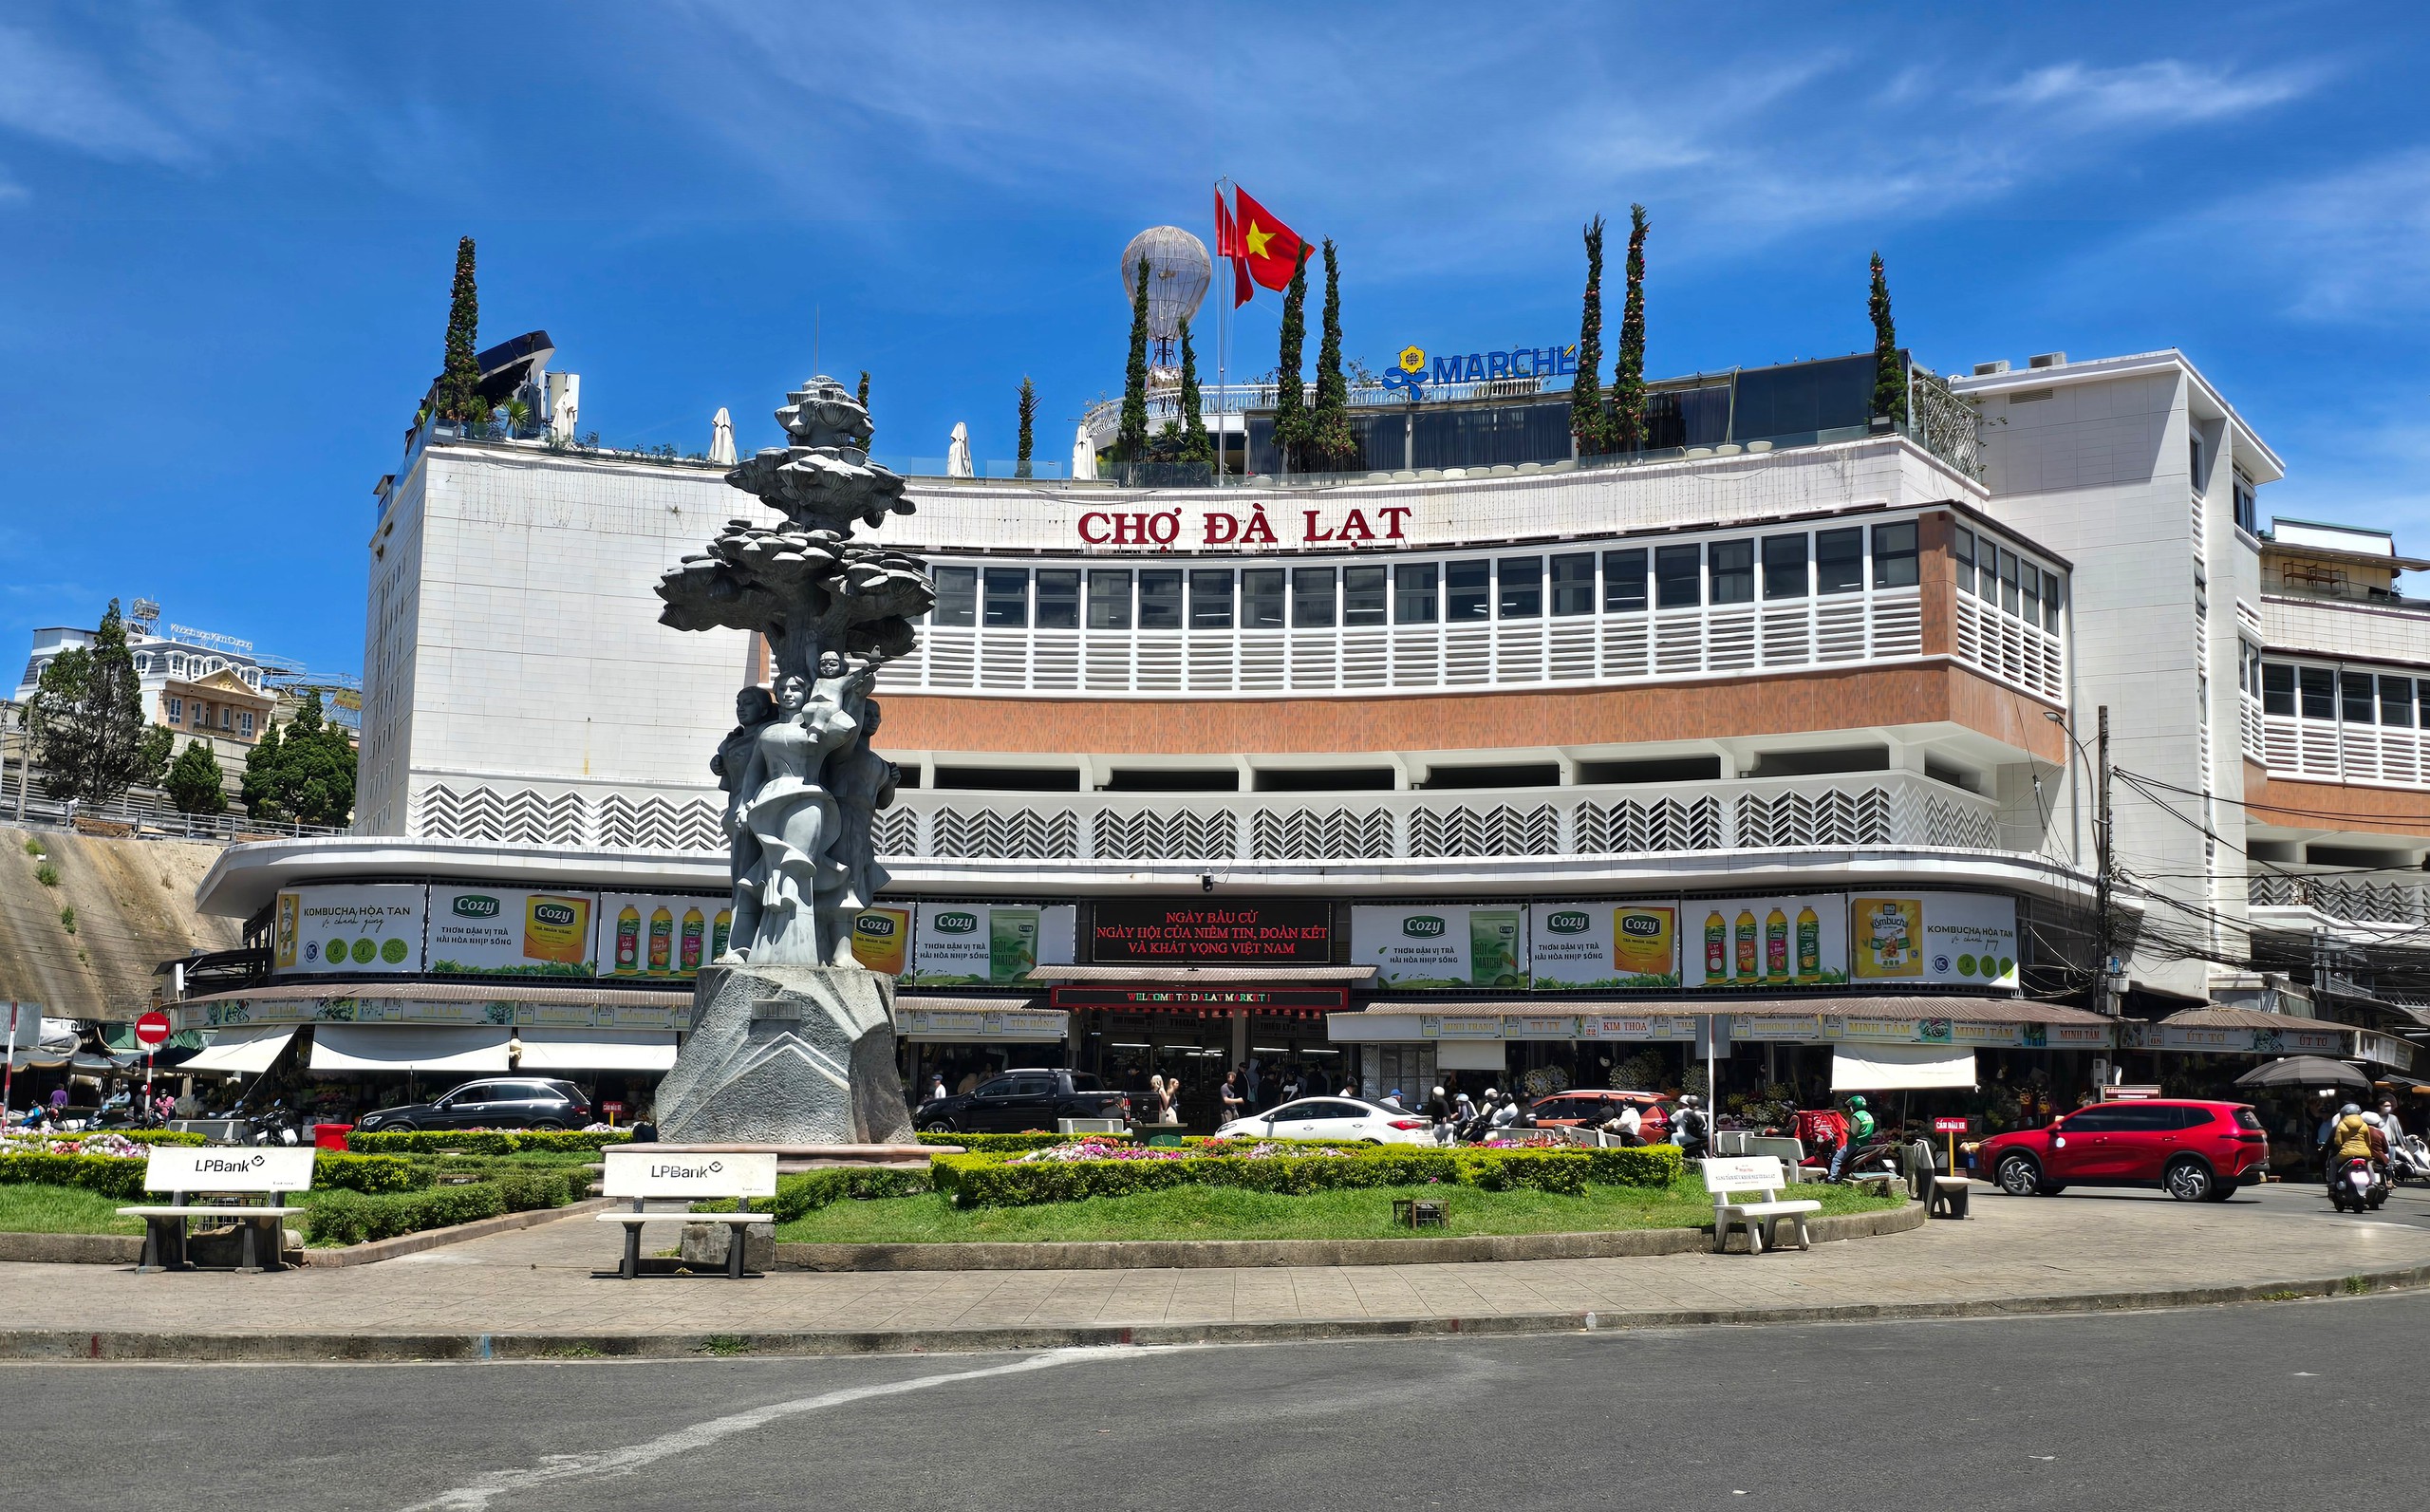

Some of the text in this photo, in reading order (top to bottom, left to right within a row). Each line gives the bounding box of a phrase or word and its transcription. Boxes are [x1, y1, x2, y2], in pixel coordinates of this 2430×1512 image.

[1432, 344, 1578, 385] MARCHÉ
[1077, 503, 1412, 553] CHỢ ĐÀ LẠT
[304, 905, 411, 917] KOMBUCHA HÒA TAN
[457, 898, 496, 914] Cozy
[537, 905, 571, 923] Cozy
[1166, 909, 1205, 924] NGÀY
[859, 918, 891, 934] Cozy
[938, 914, 974, 930] Cozy
[1406, 919, 1442, 934] Cozy
[1550, 914, 1585, 930] Cozy
[1625, 918, 1657, 933] Cozy
[494, 926, 509, 936] TRÀ
[1096, 924, 1134, 938] NGÀY
[1137, 925, 1161, 941] HỘI
[1164, 926, 1192, 939] CỦA
[1232, 928, 1257, 941] TIN,
[1260, 925, 1299, 939] ĐOÀN
[1300, 924, 1327, 939] KẾT
[1927, 925, 2013, 938] KOMBUCHA HÒA TAN
[925, 942, 945, 950] THƠM
[971, 942, 986, 950] TRÀ
[1128, 940, 1296, 956] VÀ KHÁT VỌNG VIỆT NAM
[1393, 945, 1414, 954] THƠM
[1440, 945, 1455, 954] TRÀ
[1538, 943, 1560, 951] THƠM
[969, 951, 989, 960] SỐNG
[994, 954, 1021, 966] MATCHA
[1438, 955, 1458, 963] SỐNG
[1583, 951, 1603, 960] SỐNG
[1475, 957, 1504, 969] MATCHA
[1127, 993, 1174, 1001] WELCOME
[1176, 993, 1189, 1001] TO
[1190, 993, 1224, 1001] DALAT
[1224, 993, 1266, 1001] MARKET
[1603, 1021, 1647, 1031] KIM THOA
[1848, 1022, 1880, 1034] MINH
[1884, 1021, 1911, 1034] TÂM
[1954, 1025, 2013, 1038] MINH TÂM
[2060, 1030, 2083, 1039] MINH
[2186, 1030, 2203, 1042] ÚT
[2299, 1034, 2312, 1046] ÚT
[195, 1159, 250, 1173] LPBank
[651, 1165, 708, 1179] LPBank
